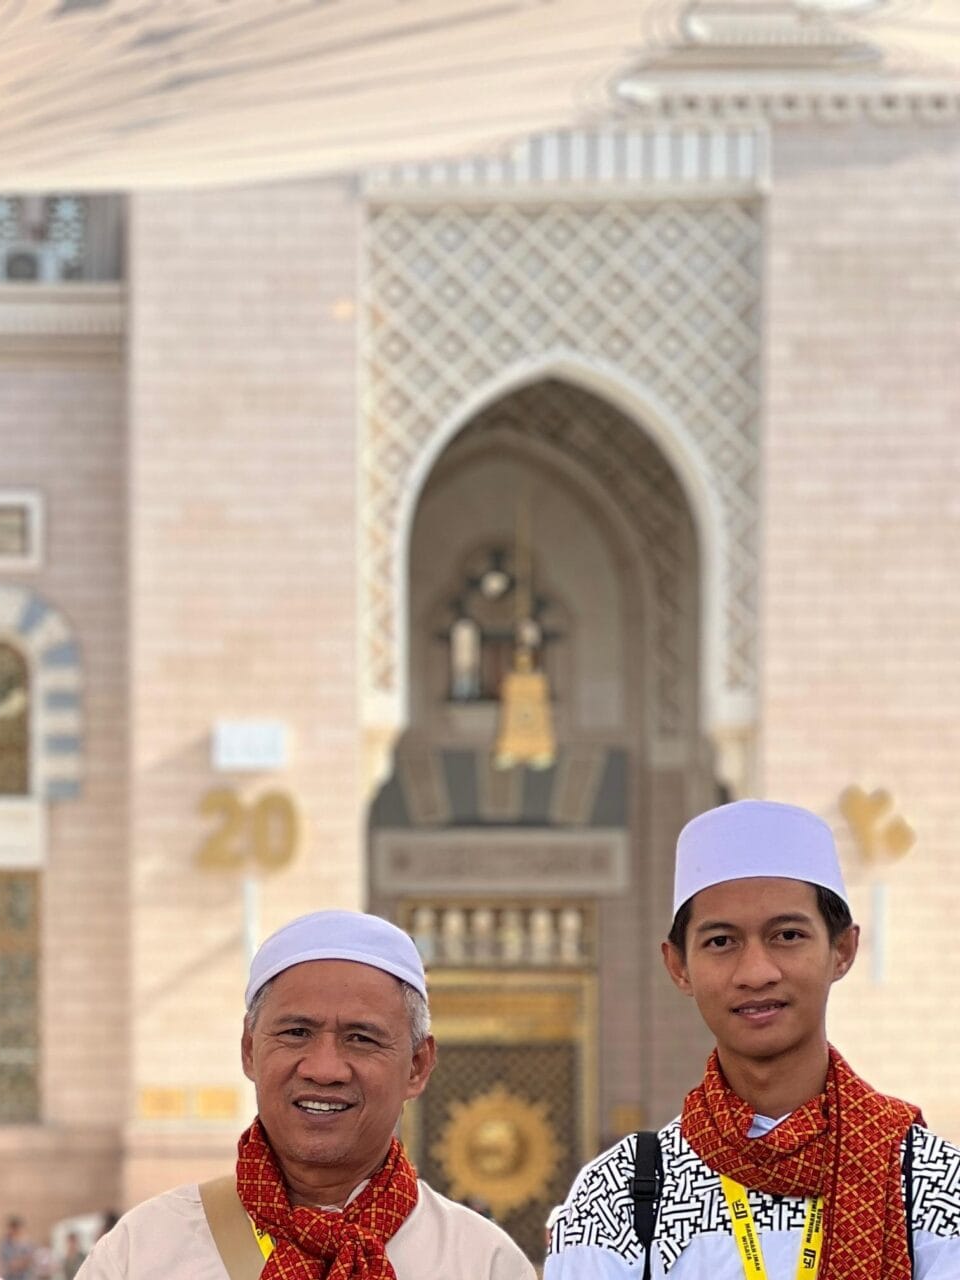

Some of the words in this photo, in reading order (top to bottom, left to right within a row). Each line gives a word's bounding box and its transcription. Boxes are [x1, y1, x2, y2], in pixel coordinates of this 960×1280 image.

[193, 787, 298, 874] 20
[742, 1236, 752, 1260] WISATA
[745, 1223, 757, 1252] MADINAH
